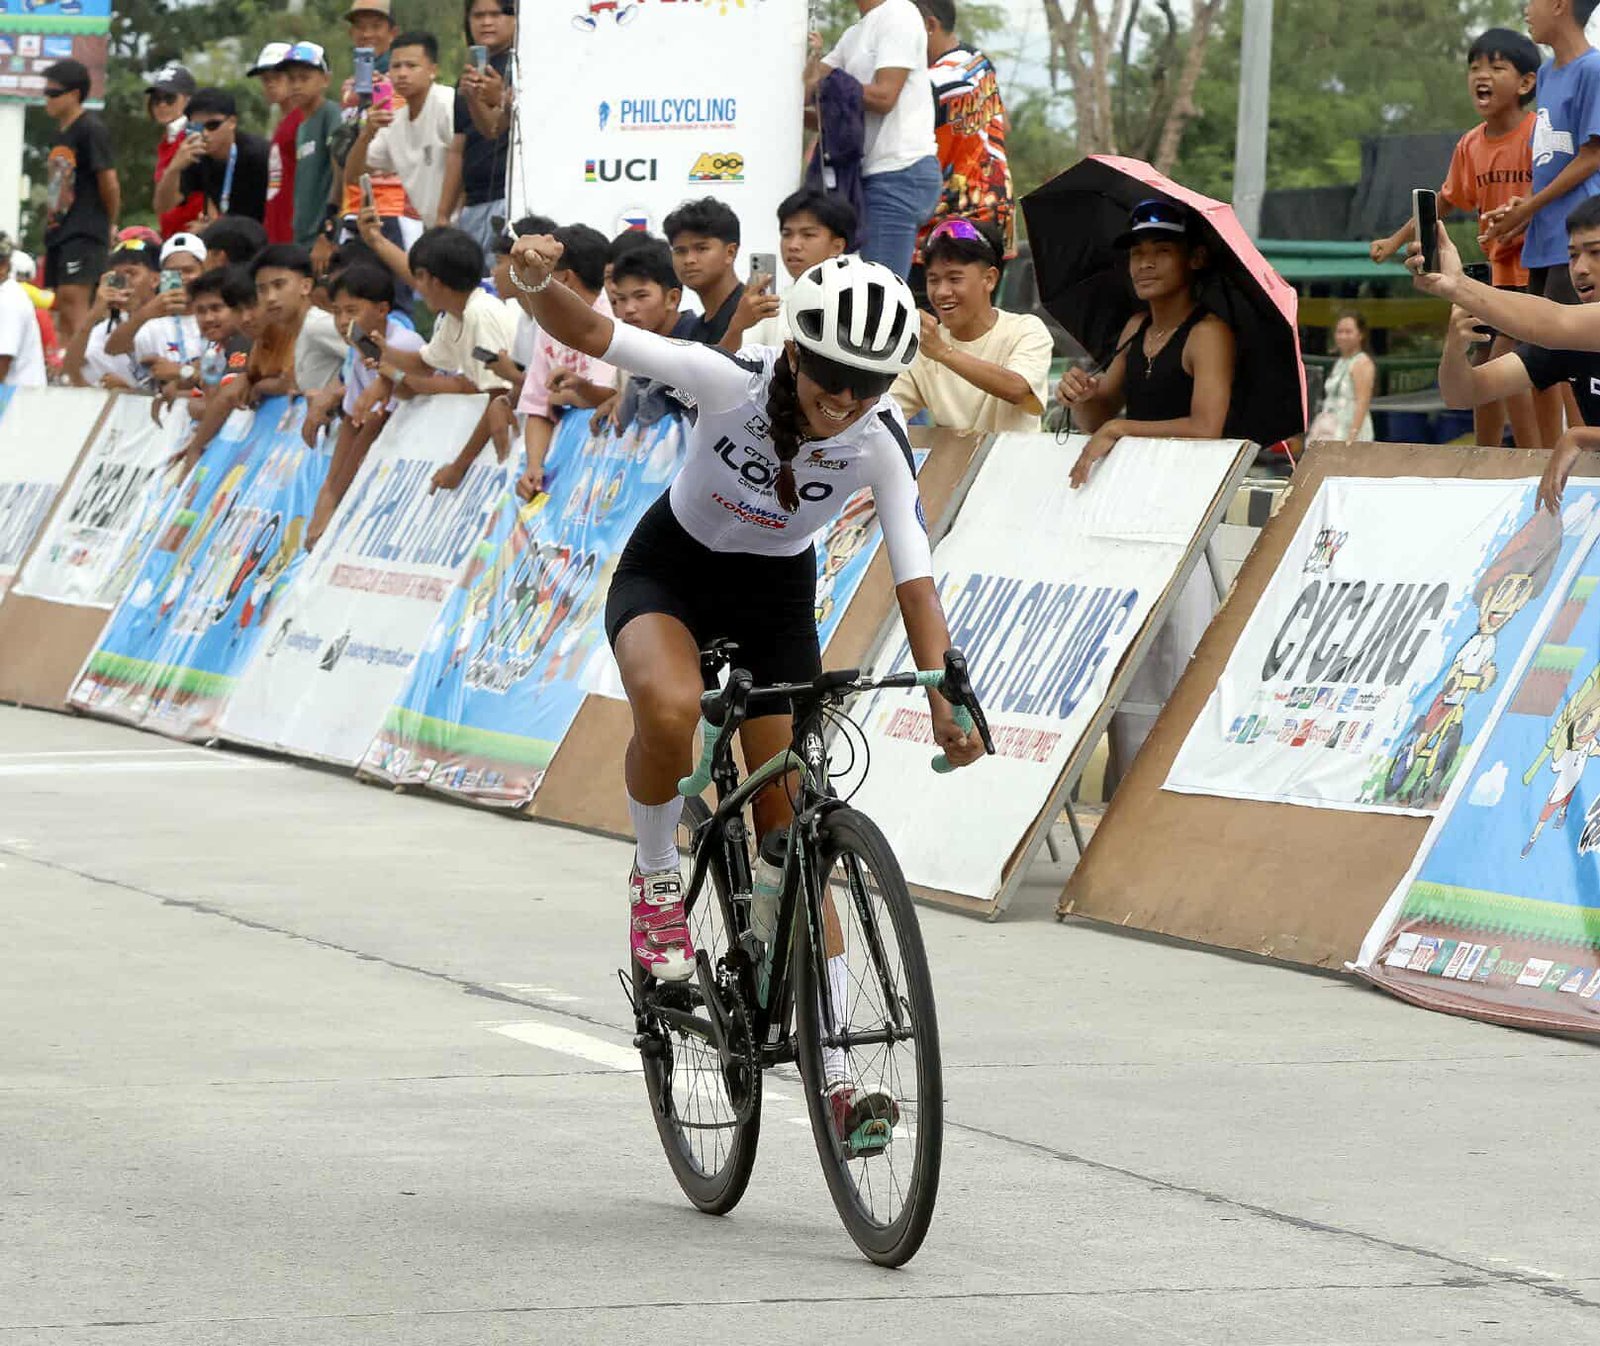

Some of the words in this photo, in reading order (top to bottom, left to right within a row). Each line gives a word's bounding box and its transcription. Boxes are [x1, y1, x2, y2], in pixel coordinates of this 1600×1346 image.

[620, 98, 736, 123] PHILCYCLING
[599, 158, 657, 182] UCI
[1262, 580, 1449, 686] CYCLING
